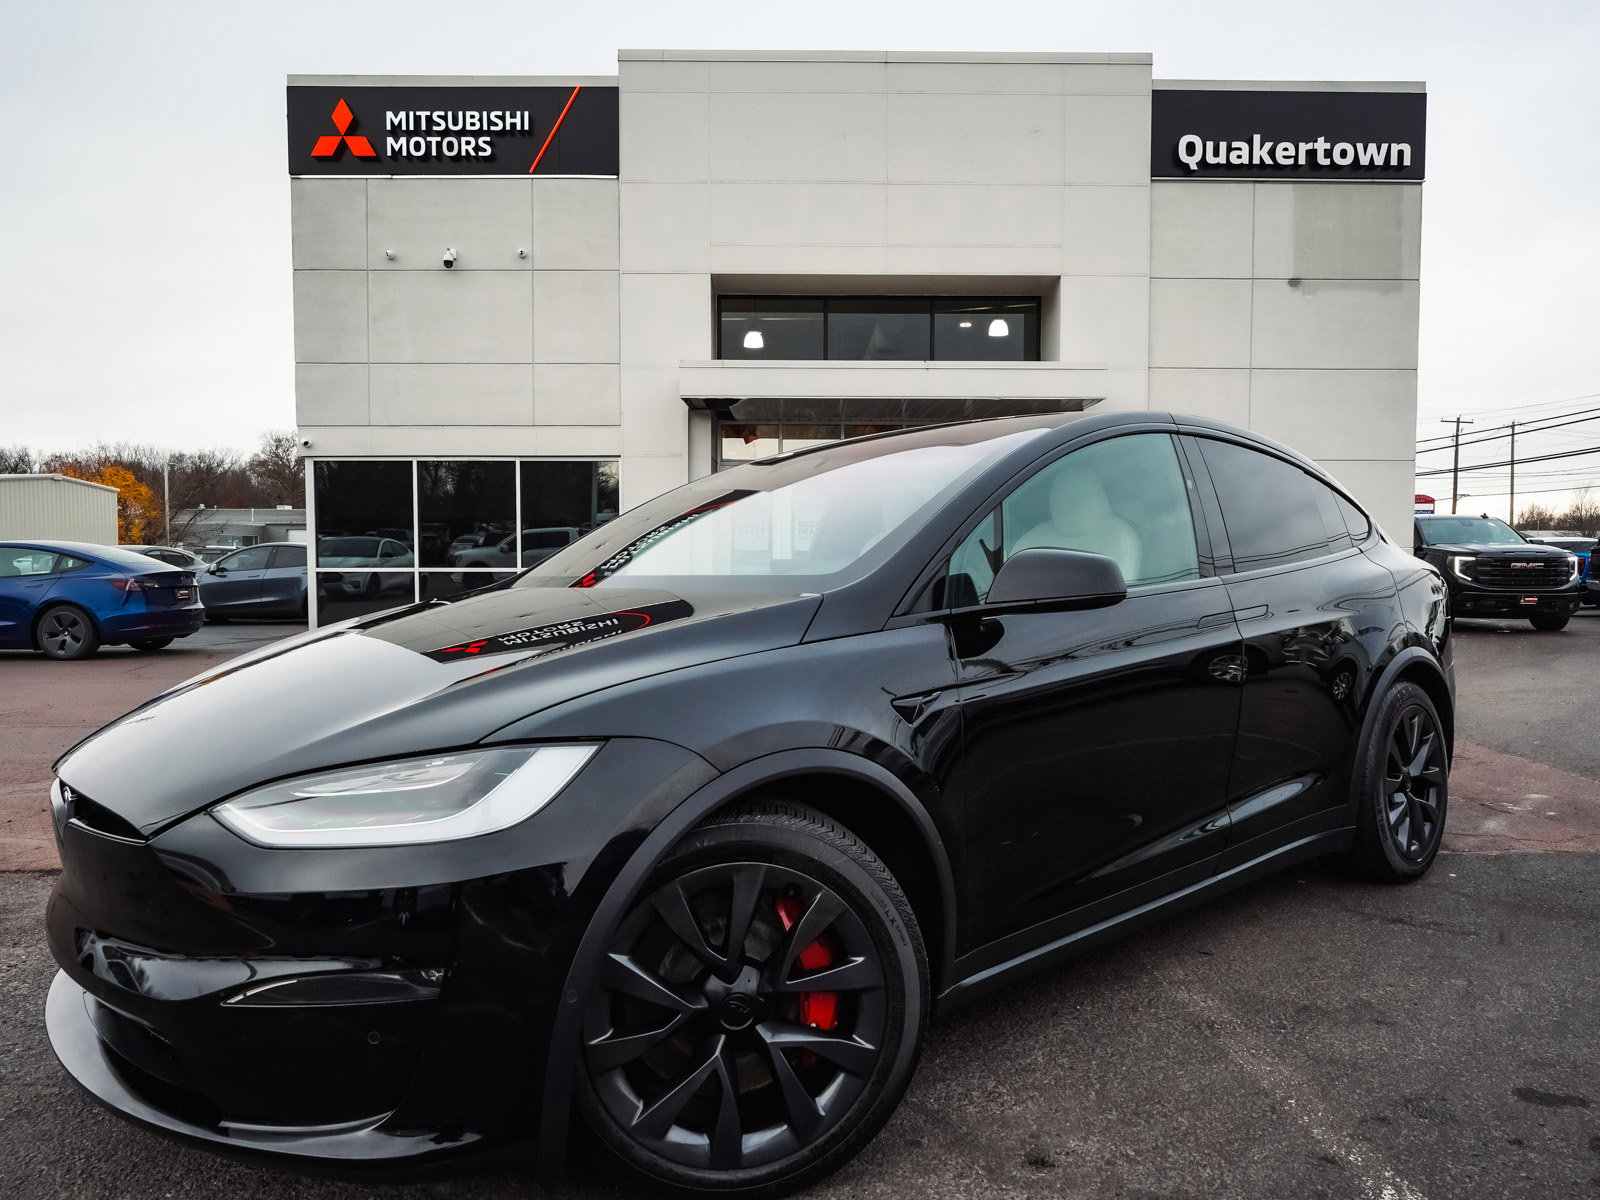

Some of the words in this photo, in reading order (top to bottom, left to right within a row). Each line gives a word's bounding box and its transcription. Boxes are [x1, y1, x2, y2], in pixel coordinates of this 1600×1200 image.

[385, 111, 530, 131] MITSUBISHI
[385, 136, 492, 157] MOTORS
[1178, 133, 1412, 171] Quakertown
[1511, 562, 1545, 570] GMC
